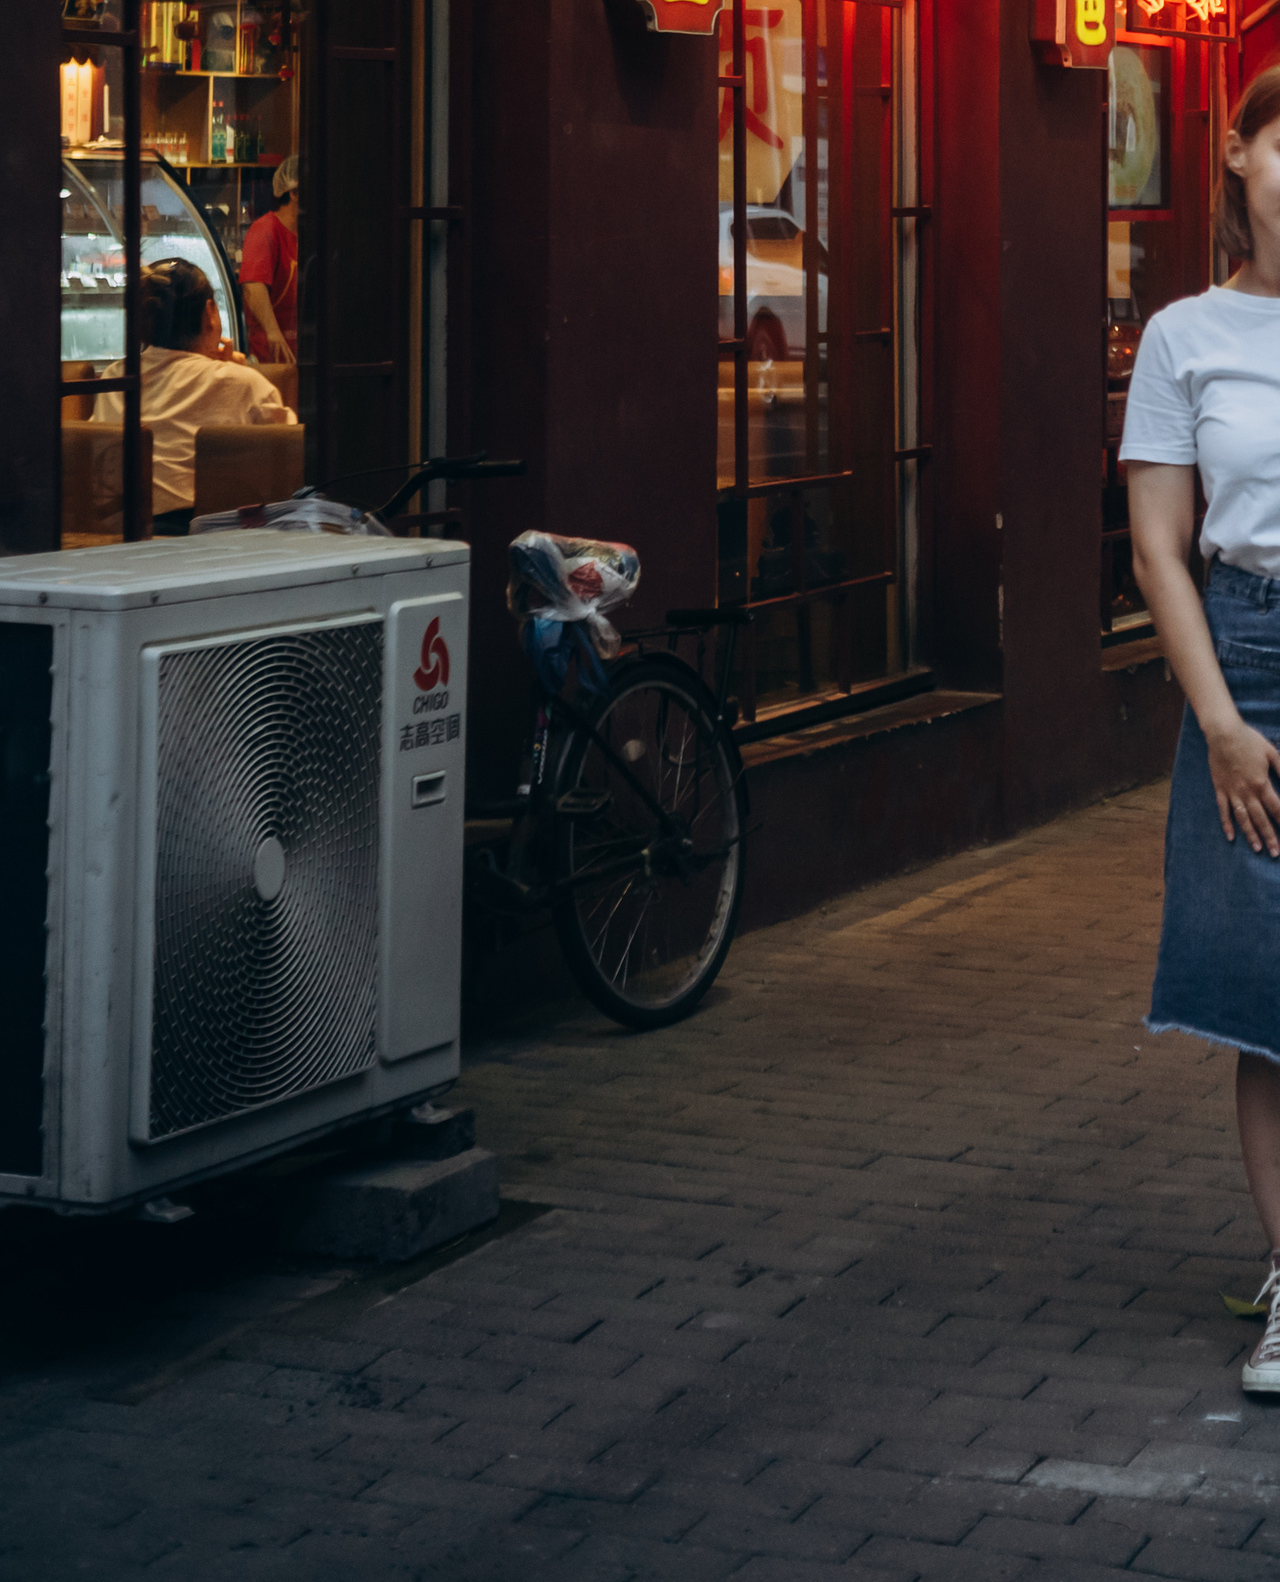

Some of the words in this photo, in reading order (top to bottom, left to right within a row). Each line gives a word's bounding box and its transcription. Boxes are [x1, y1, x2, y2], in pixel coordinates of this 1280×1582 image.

[412, 691, 449, 715] CHIGO
[400, 713, 461, 752] 志高空调
